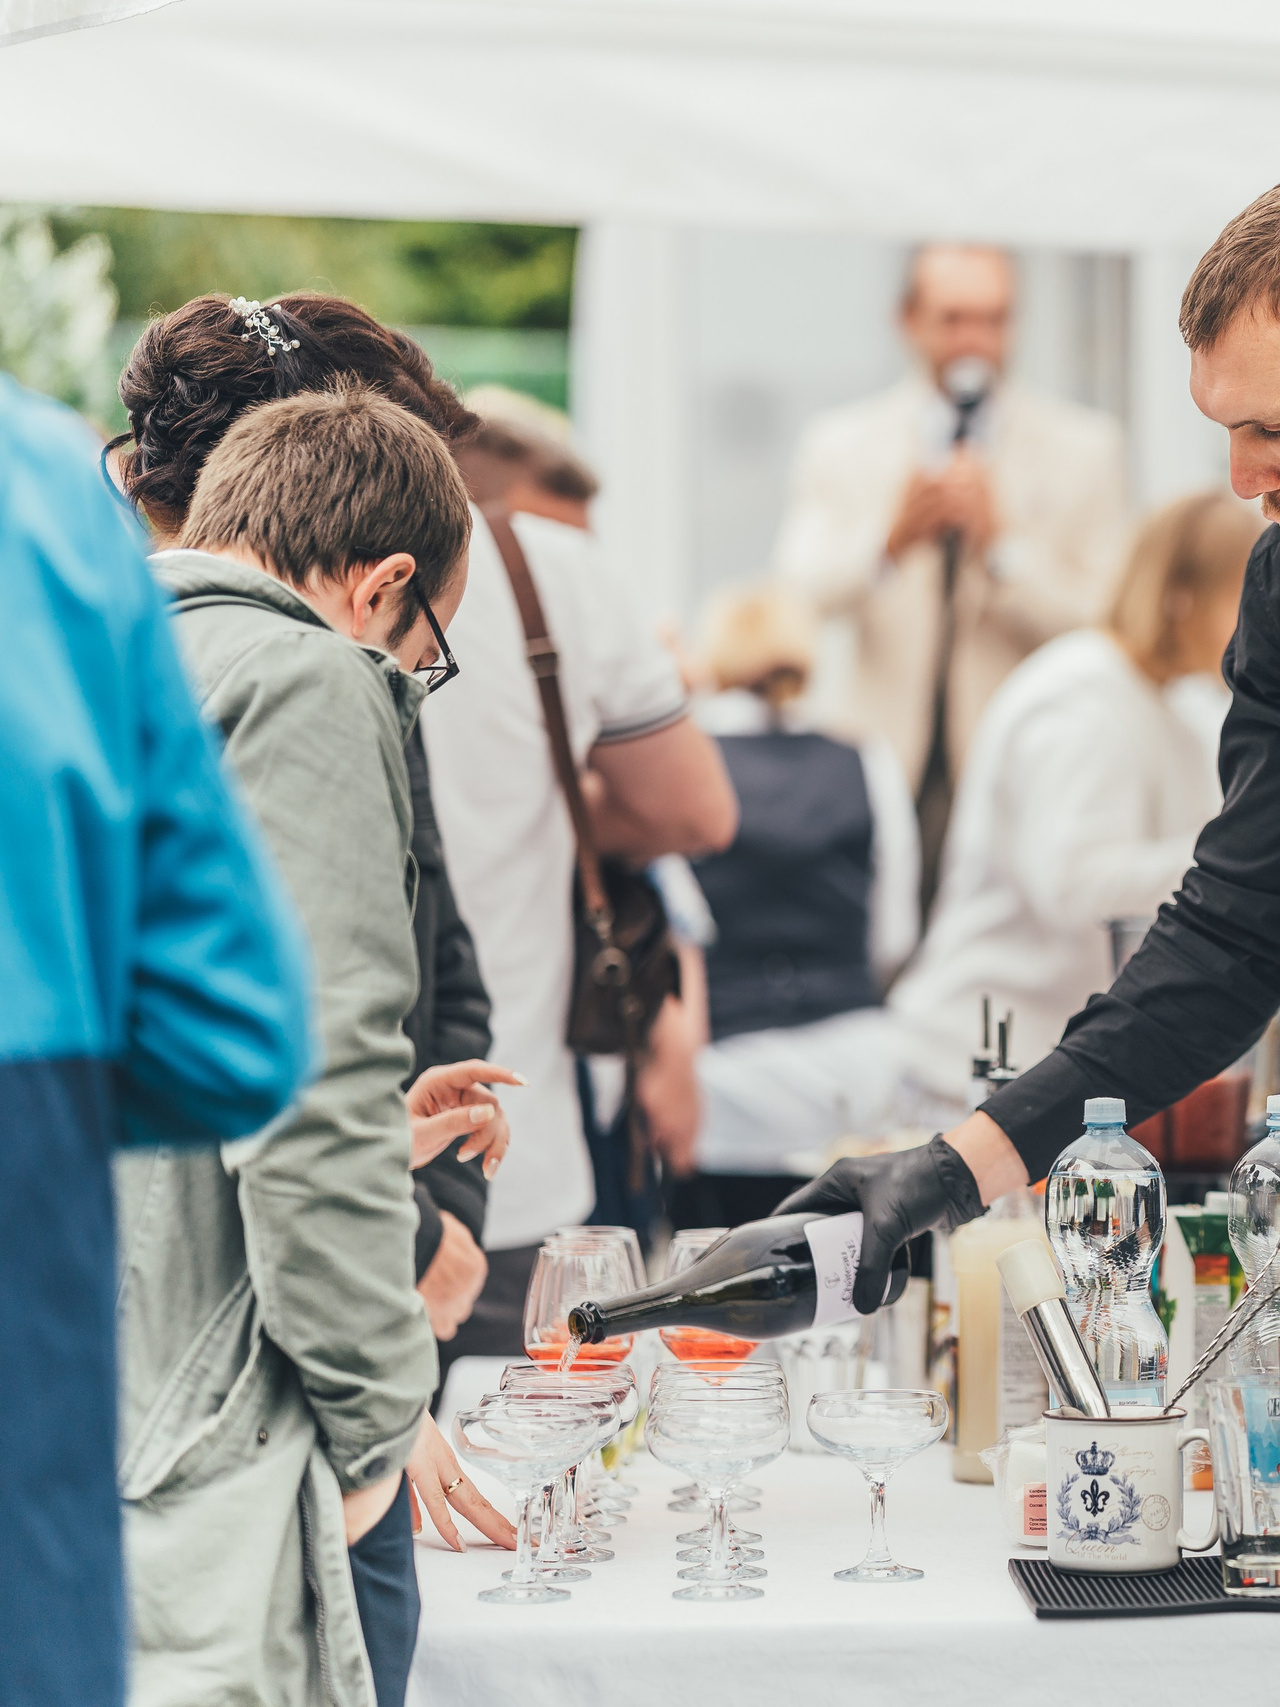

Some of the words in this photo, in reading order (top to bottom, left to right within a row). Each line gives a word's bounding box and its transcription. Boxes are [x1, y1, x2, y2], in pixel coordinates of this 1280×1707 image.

[1065, 1531, 1117, 1554] Queen
[1087, 1552, 1102, 1560] The
[1105, 1553, 1128, 1561] World
